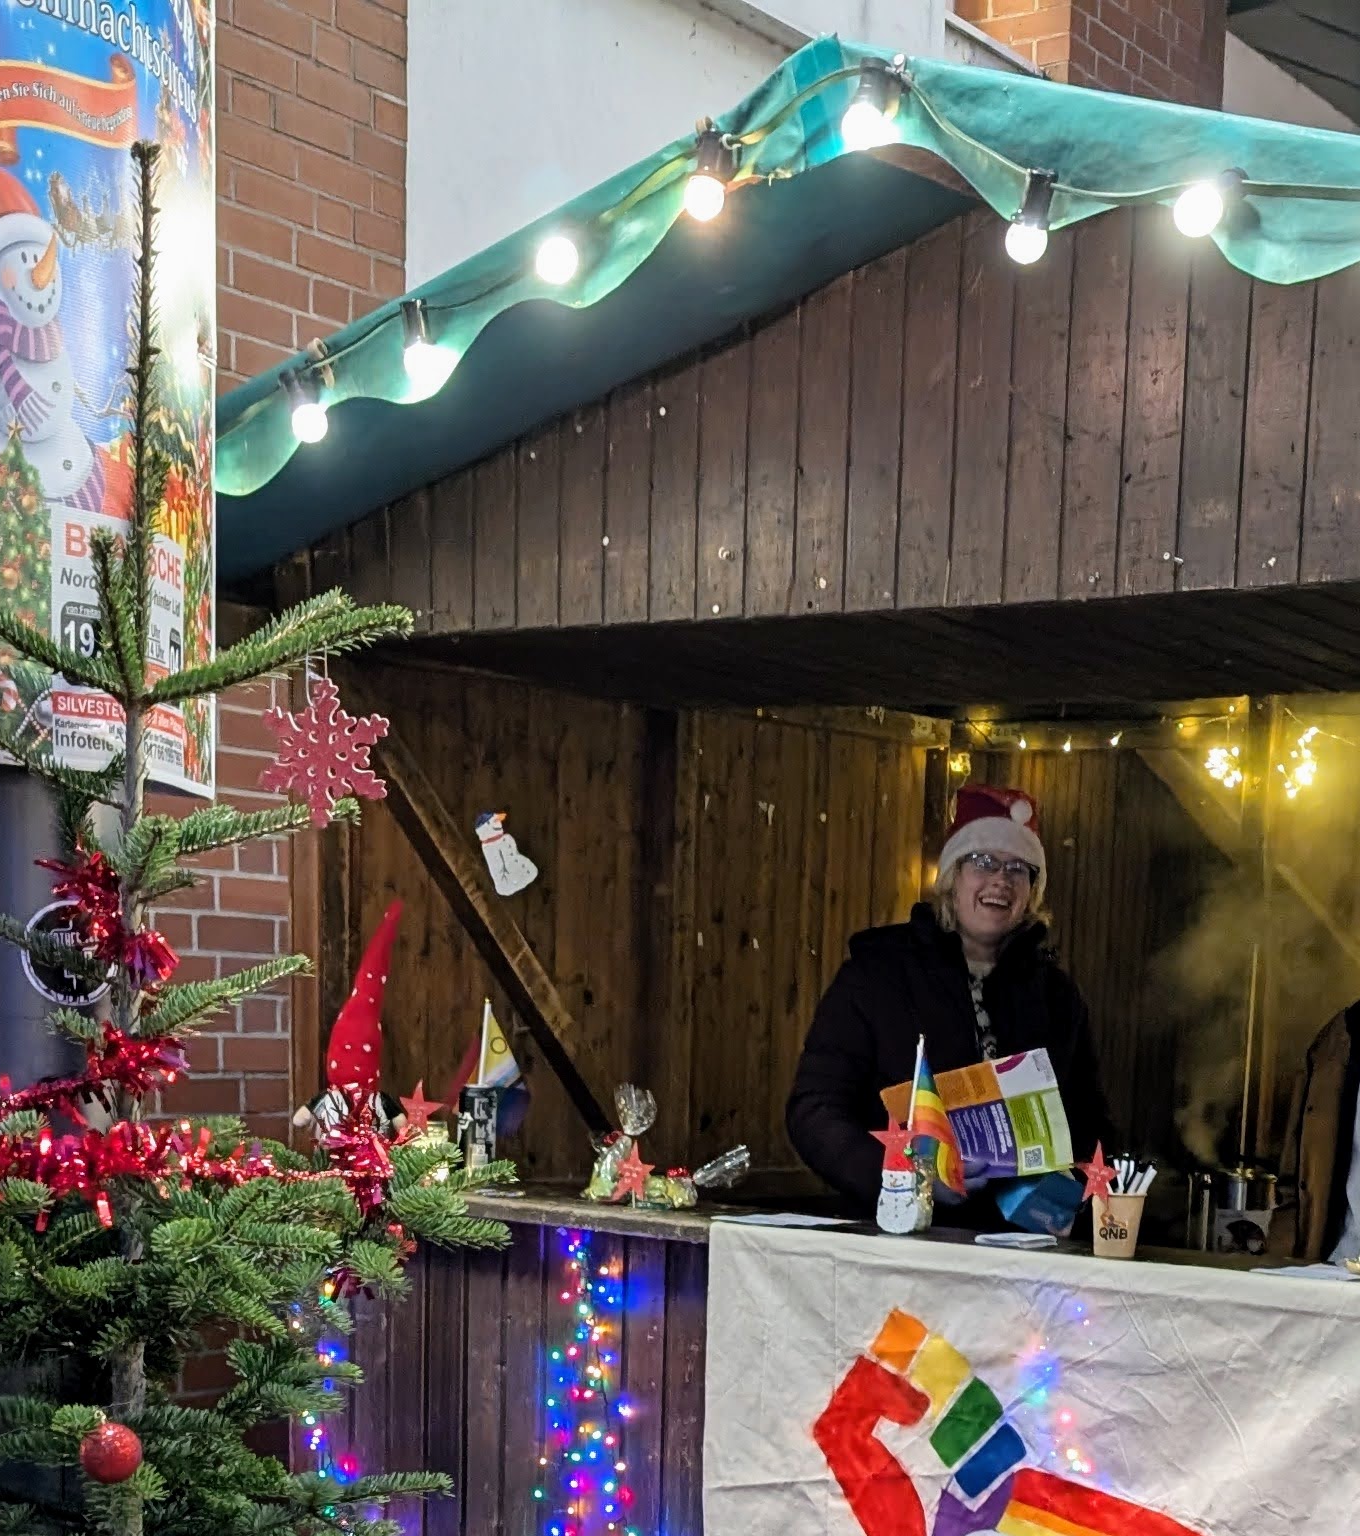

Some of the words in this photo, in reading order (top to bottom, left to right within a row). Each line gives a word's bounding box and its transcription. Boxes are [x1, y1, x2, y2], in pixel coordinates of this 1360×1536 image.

[12, 82, 30, 98] Sie
[31, 82, 56, 103] Sich
[1099, 1226, 1128, 1240] QNB
